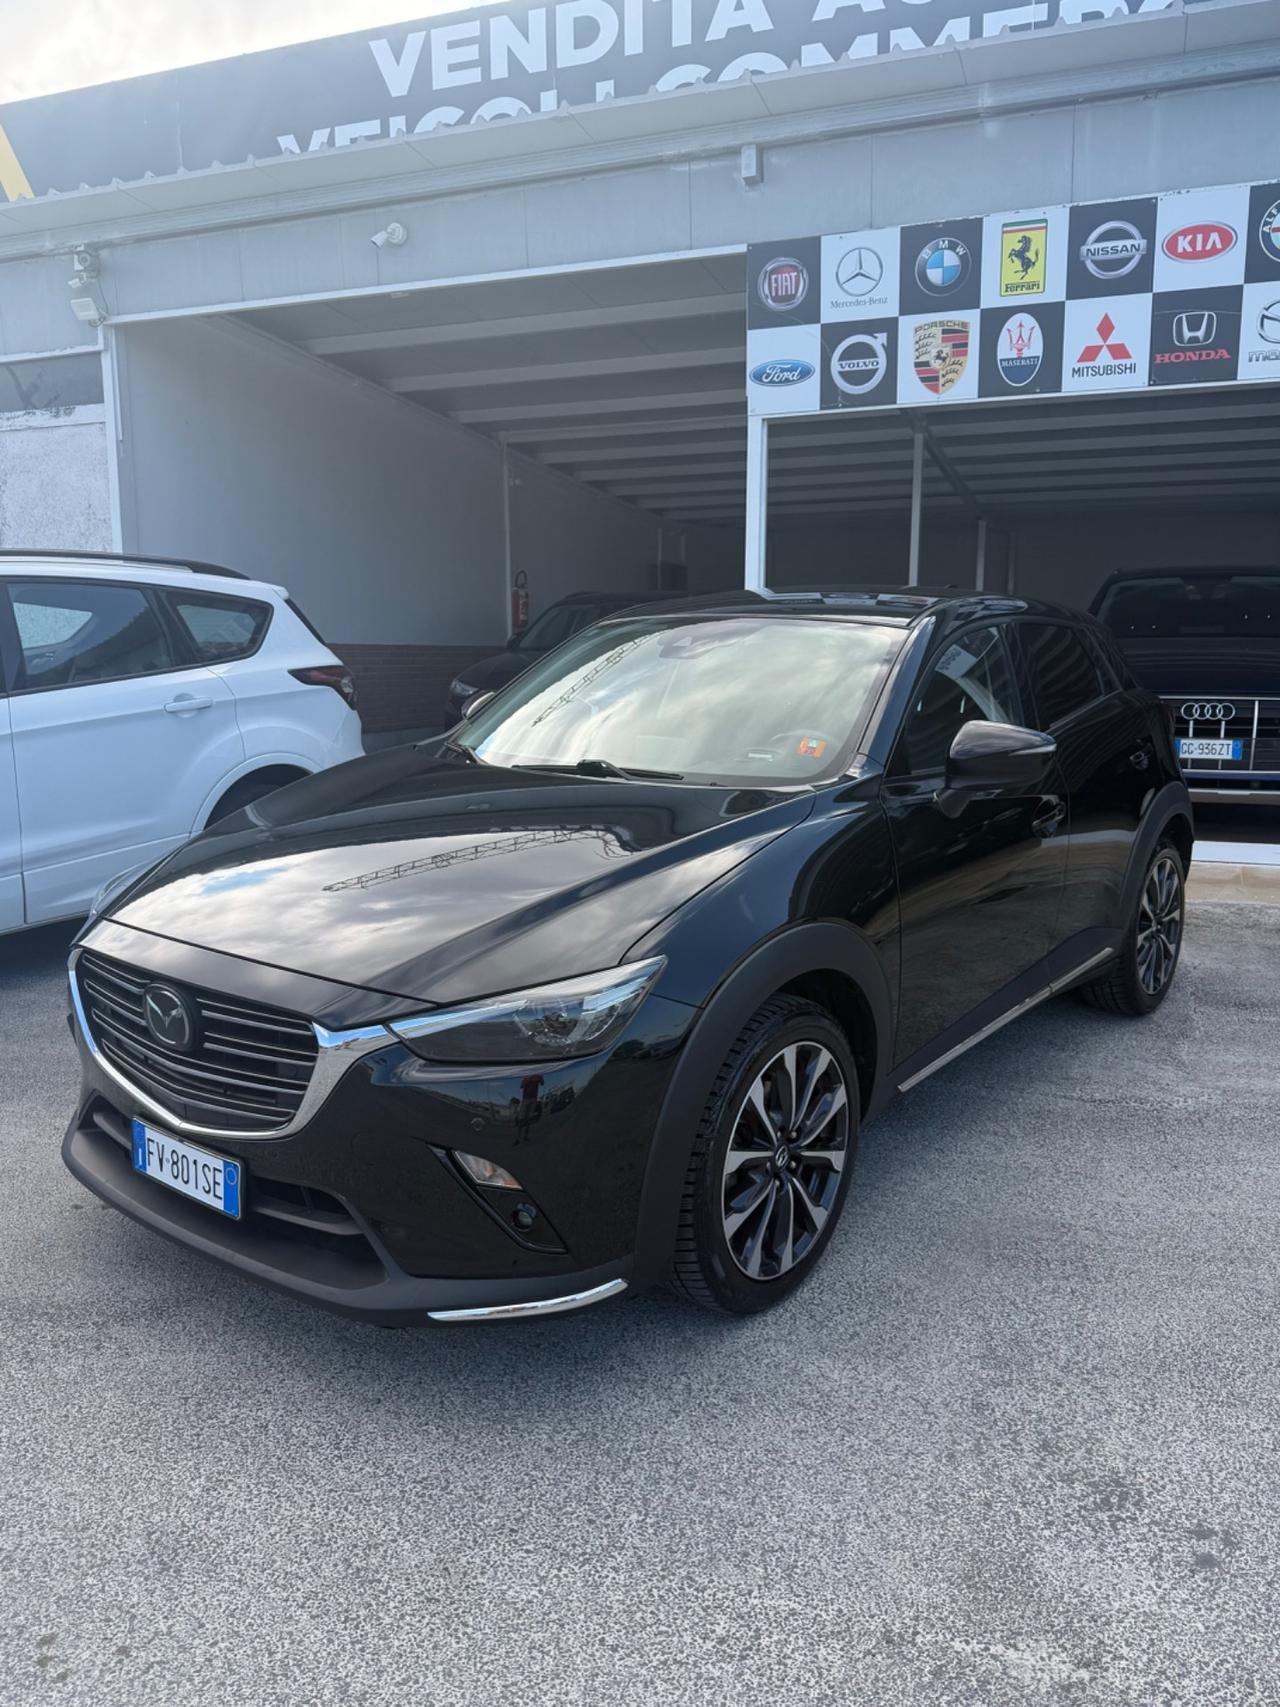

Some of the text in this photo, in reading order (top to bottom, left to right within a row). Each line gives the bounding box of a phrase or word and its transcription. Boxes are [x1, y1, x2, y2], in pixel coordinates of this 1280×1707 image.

[369, 0, 775, 98] VENDITA
[921, 238, 967, 261] BMW
[1177, 231, 1222, 253] KIA
[1086, 243, 1141, 257] NISSAN
[771, 272, 797, 297] FIAT
[1004, 281, 1041, 293] Ferrari
[830, 295, 889, 309] Mercedes-Benz
[914, 320, 970, 334] PORSCHE
[1001, 356, 1038, 367] MASERATI
[1154, 349, 1231, 364] HONDA
[838, 359, 880, 370] VOLVO
[1071, 362, 1137, 379] MITSUBISHI
[761, 364, 801, 383] Ford
